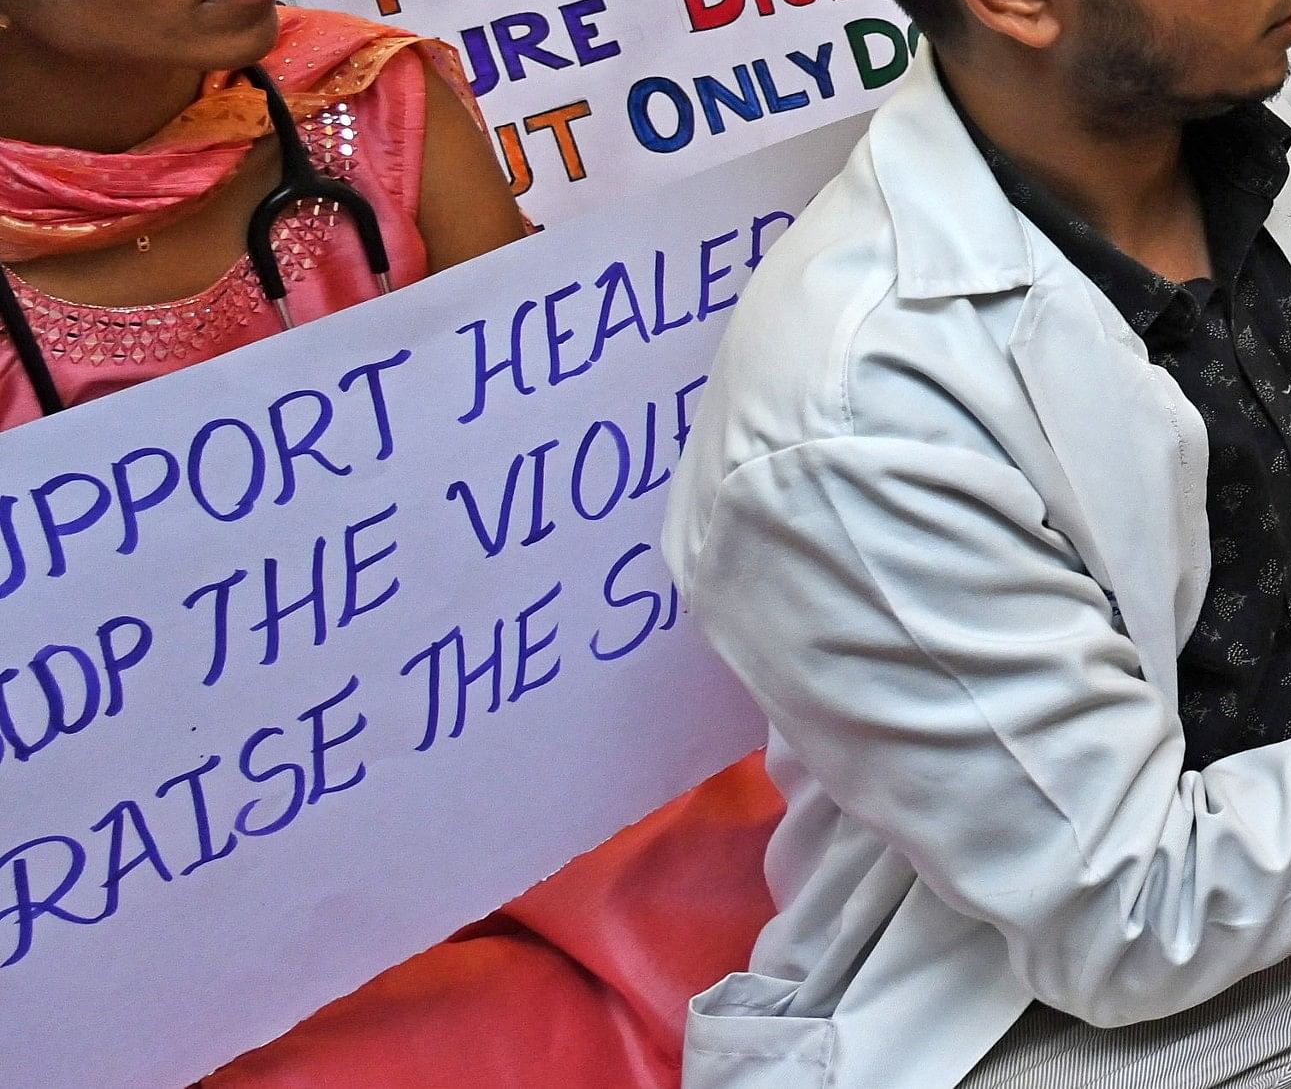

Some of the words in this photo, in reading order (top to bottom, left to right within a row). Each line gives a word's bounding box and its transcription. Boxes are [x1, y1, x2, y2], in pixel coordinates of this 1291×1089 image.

[626, 41, 836, 154] ONLY
[0, 615, 154, 764] TOP
[183, 503, 400, 688] THE
[0, 676, 368, 969] RAISE
[400, 579, 563, 753] THE
